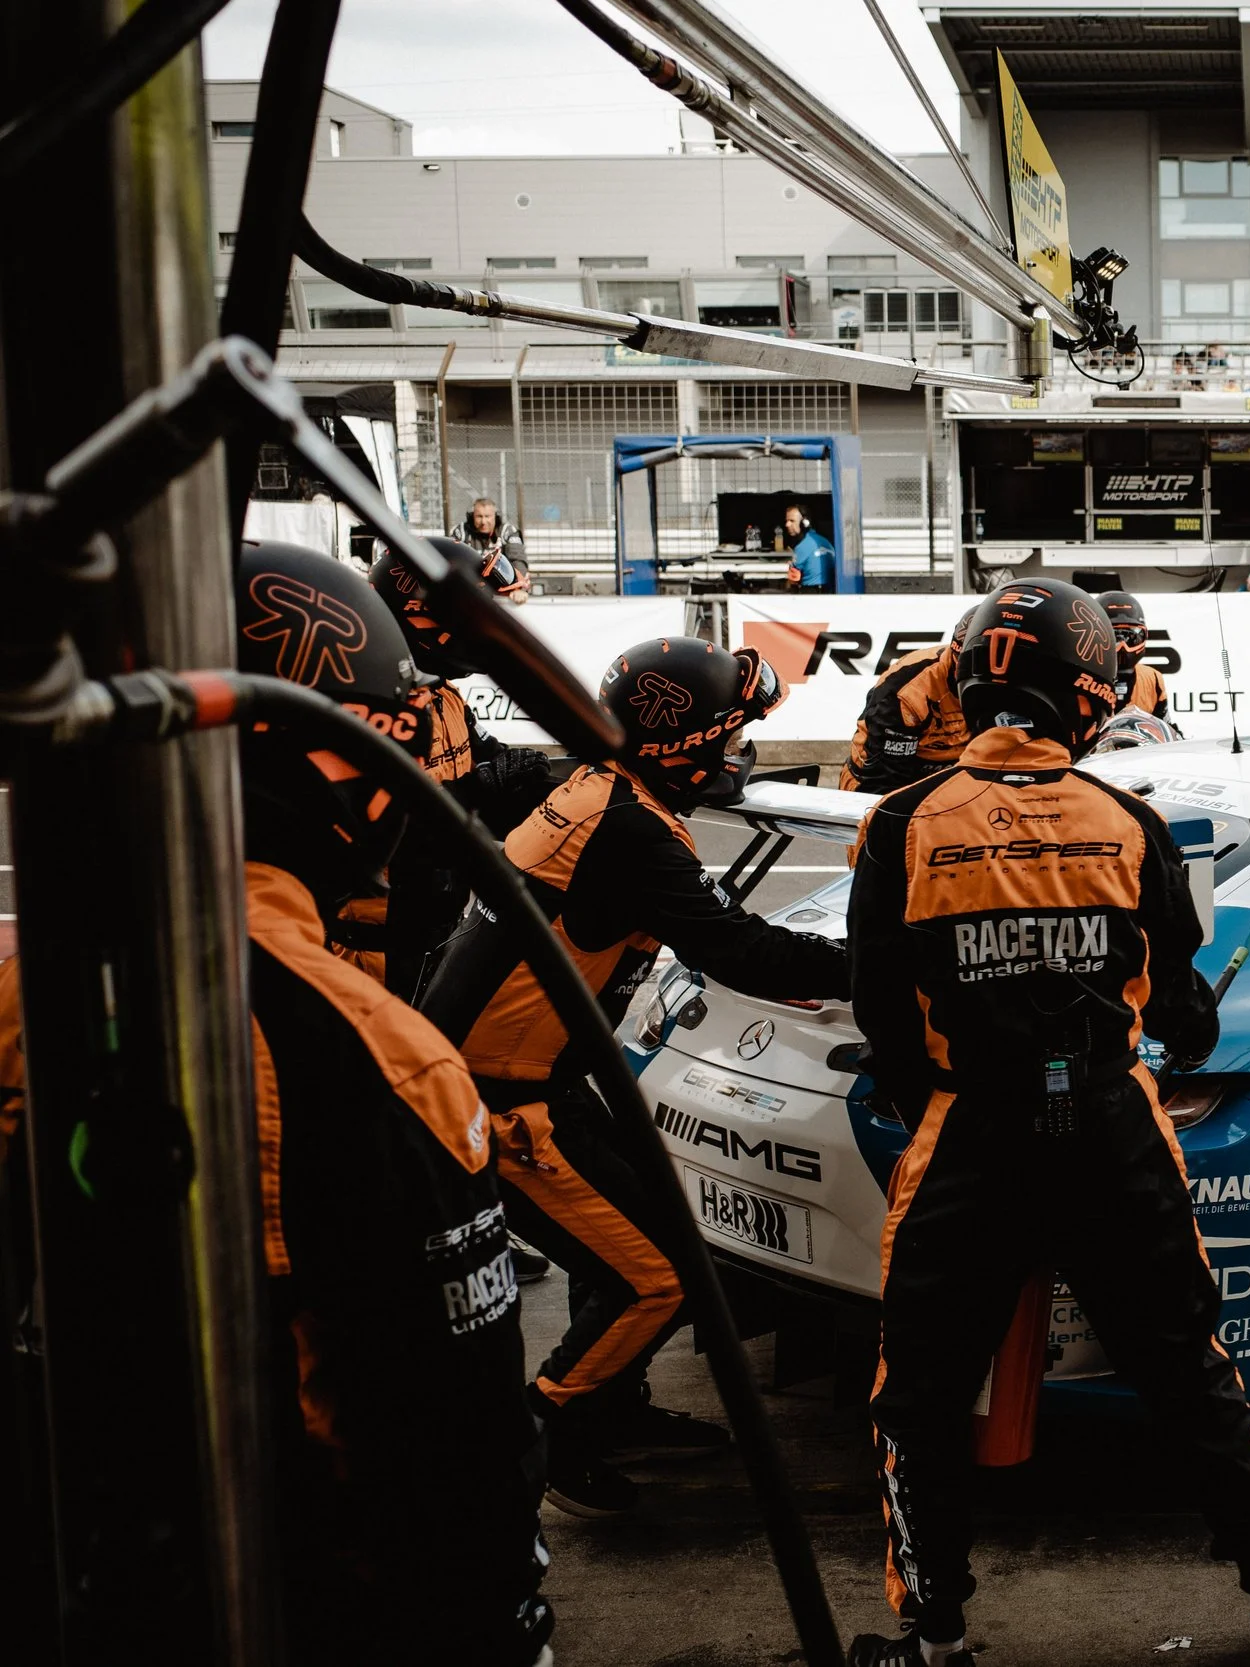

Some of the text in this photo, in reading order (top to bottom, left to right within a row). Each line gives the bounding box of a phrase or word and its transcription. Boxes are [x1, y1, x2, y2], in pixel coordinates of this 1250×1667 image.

[1103, 492, 1188, 501] MOTORSPORT
[1001, 611, 1023, 620] Tom
[955, 915, 1108, 966] RACETAXI
[958, 957, 1105, 983] under8.de
[692, 1119, 822, 1183] AMG
[700, 1177, 754, 1240] H&R
[1211, 1204, 1226, 1214] DIE
